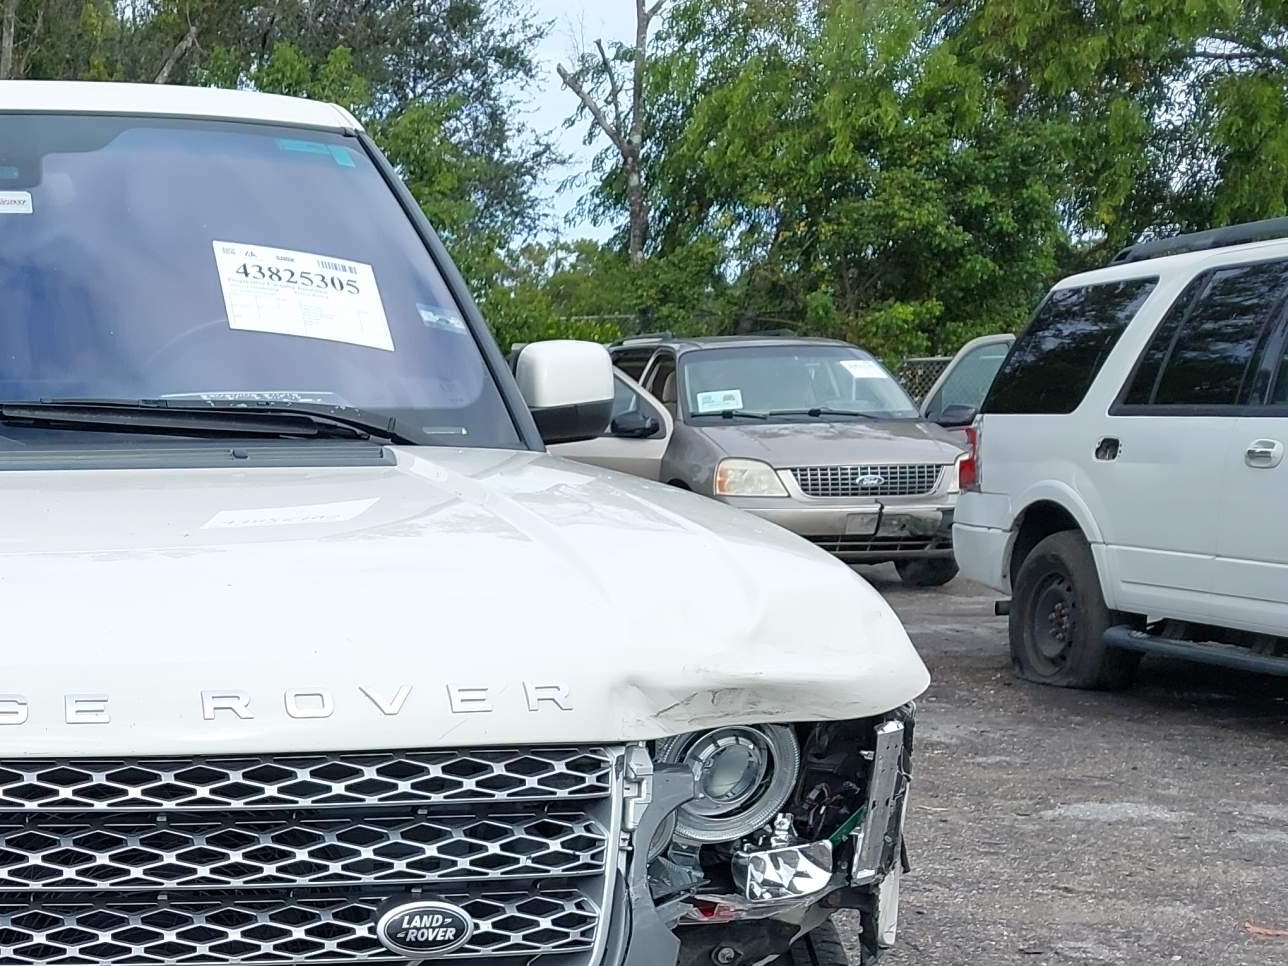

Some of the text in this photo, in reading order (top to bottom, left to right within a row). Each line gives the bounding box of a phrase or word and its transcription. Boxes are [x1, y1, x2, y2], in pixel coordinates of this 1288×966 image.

[235, 262, 361, 295] 43825305
[200, 681, 574, 721] ROVER
[401, 914, 444, 929] LAND
[405, 927, 457, 942] ROVER
